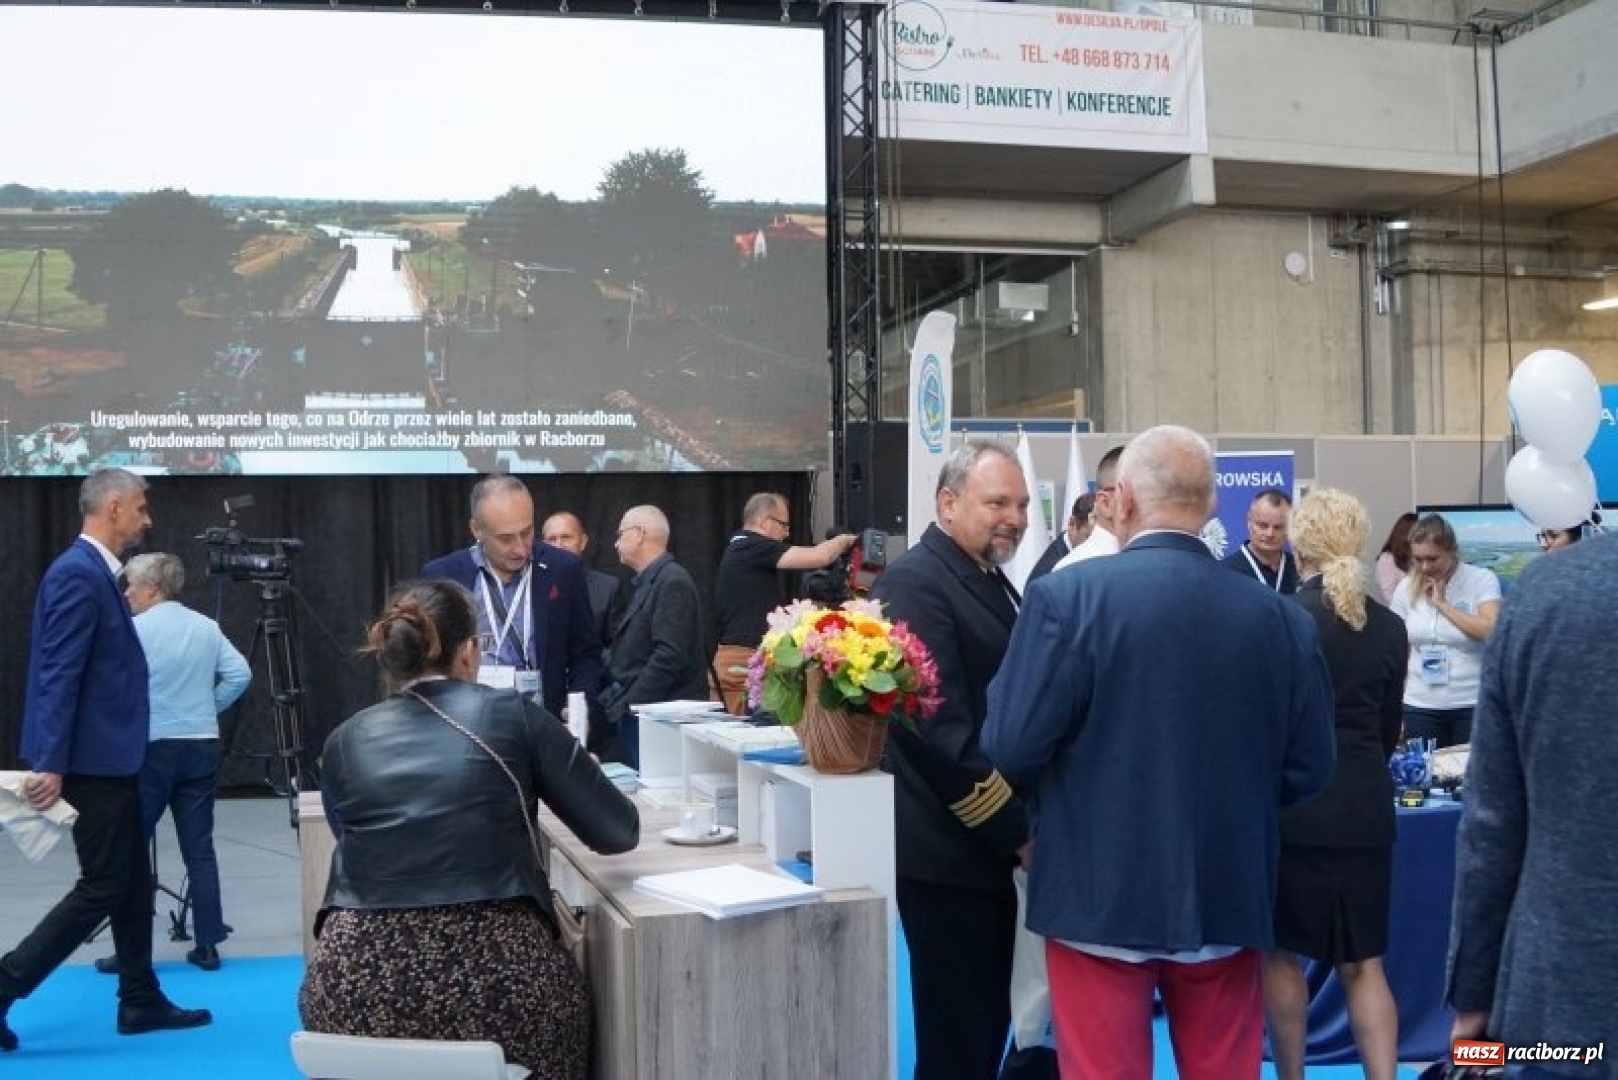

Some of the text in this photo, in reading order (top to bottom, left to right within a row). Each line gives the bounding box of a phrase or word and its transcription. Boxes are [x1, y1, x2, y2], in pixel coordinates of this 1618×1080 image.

[1019, 44, 1049, 63] TEL.
[1053, 47, 1080, 66] +48
[1083, 48, 1110, 68] 668
[1113, 50, 1140, 70] 873
[1144, 52, 1171, 72] 714
[881, 80, 1172, 117] CATERING BANKIETY KONFERENCJE
[90, 410, 638, 430] Uregulowanie, wsparcie tego, co na Odrze przez wiele lat zostało zaniedbane,
[128, 430, 606, 450] wybudowanie nowych inwestycji jak chociażby zbiornik w Racborzu
